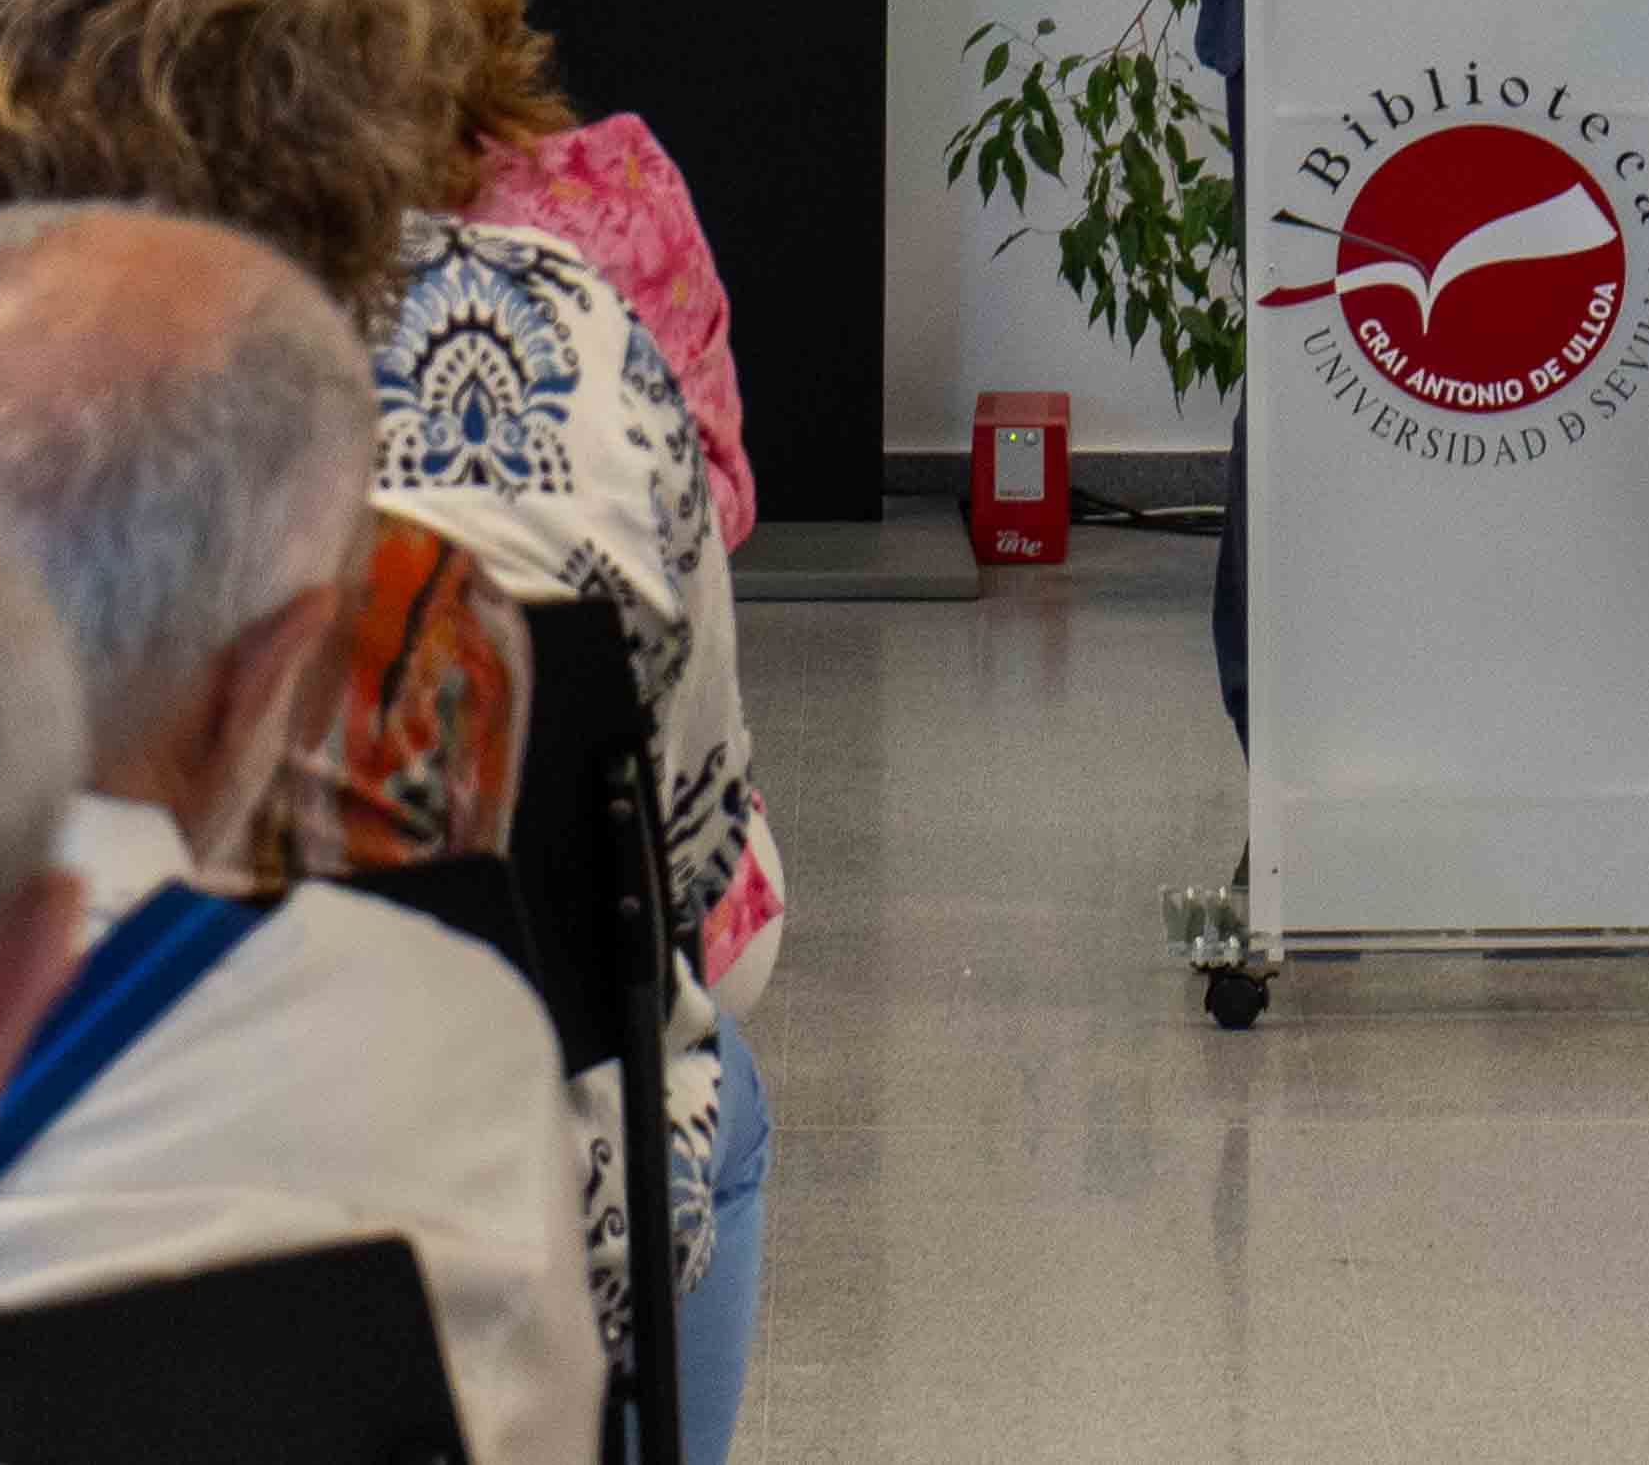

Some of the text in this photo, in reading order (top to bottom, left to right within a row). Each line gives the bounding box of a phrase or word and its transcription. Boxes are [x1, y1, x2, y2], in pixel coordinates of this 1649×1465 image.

[1301, 326, 1548, 467] UNIVERSIDAD
[1357, 280, 1618, 409] CRAI ANTONIO DE ULLOA
